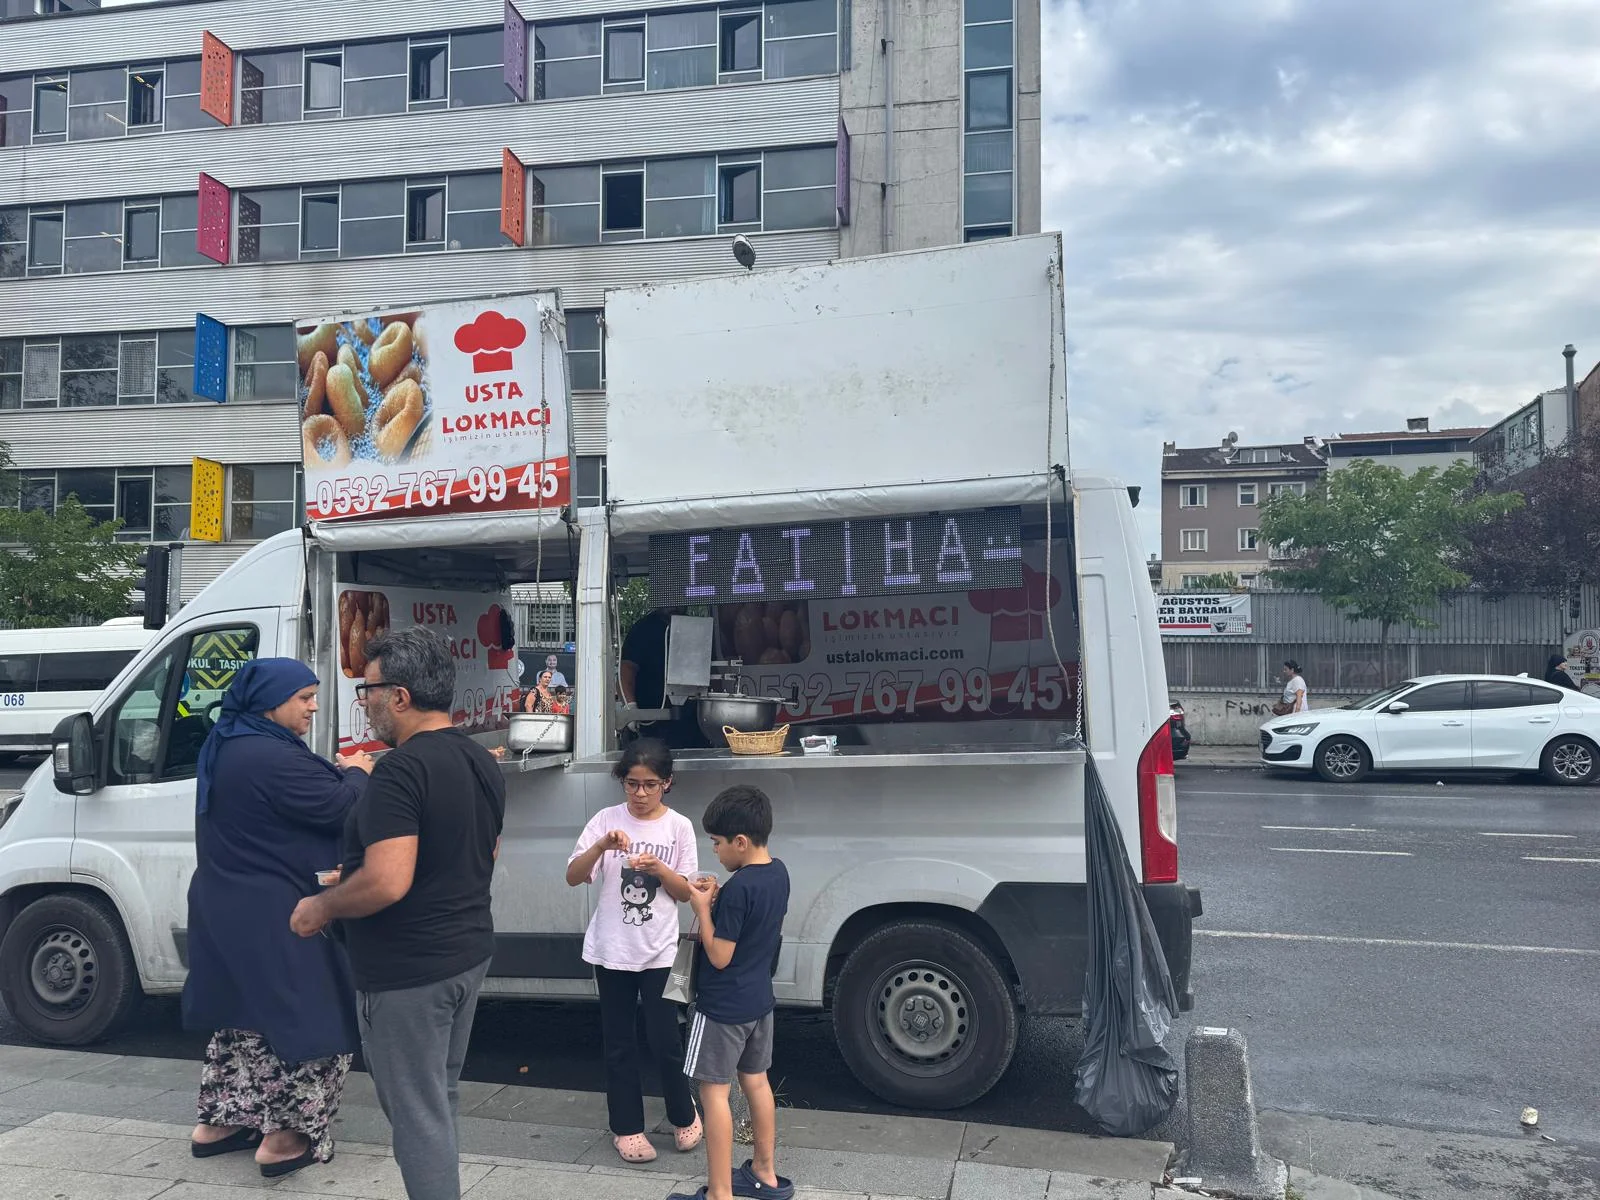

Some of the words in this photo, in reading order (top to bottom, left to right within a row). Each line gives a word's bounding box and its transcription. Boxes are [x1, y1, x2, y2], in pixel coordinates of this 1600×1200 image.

[465, 382, 523, 403] USTA
[442, 408, 551, 434] LOKMACI
[316, 475, 390, 516] 0532
[399, 469, 457, 509] 767
[467, 464, 507, 504] 99
[518, 462, 559, 499] 45
[413, 603, 457, 625] USTA
[822, 606, 960, 632] LOKMACI
[1178, 616, 1209, 624] OLSUN
[826, 647, 965, 665] ustalokmaci.com
[4, 694, 25, 707] 068
[845, 669, 924, 714] 767
[938, 666, 991, 713] 99
[1007, 664, 1063, 711] 45
[463, 688, 486, 727] 99
